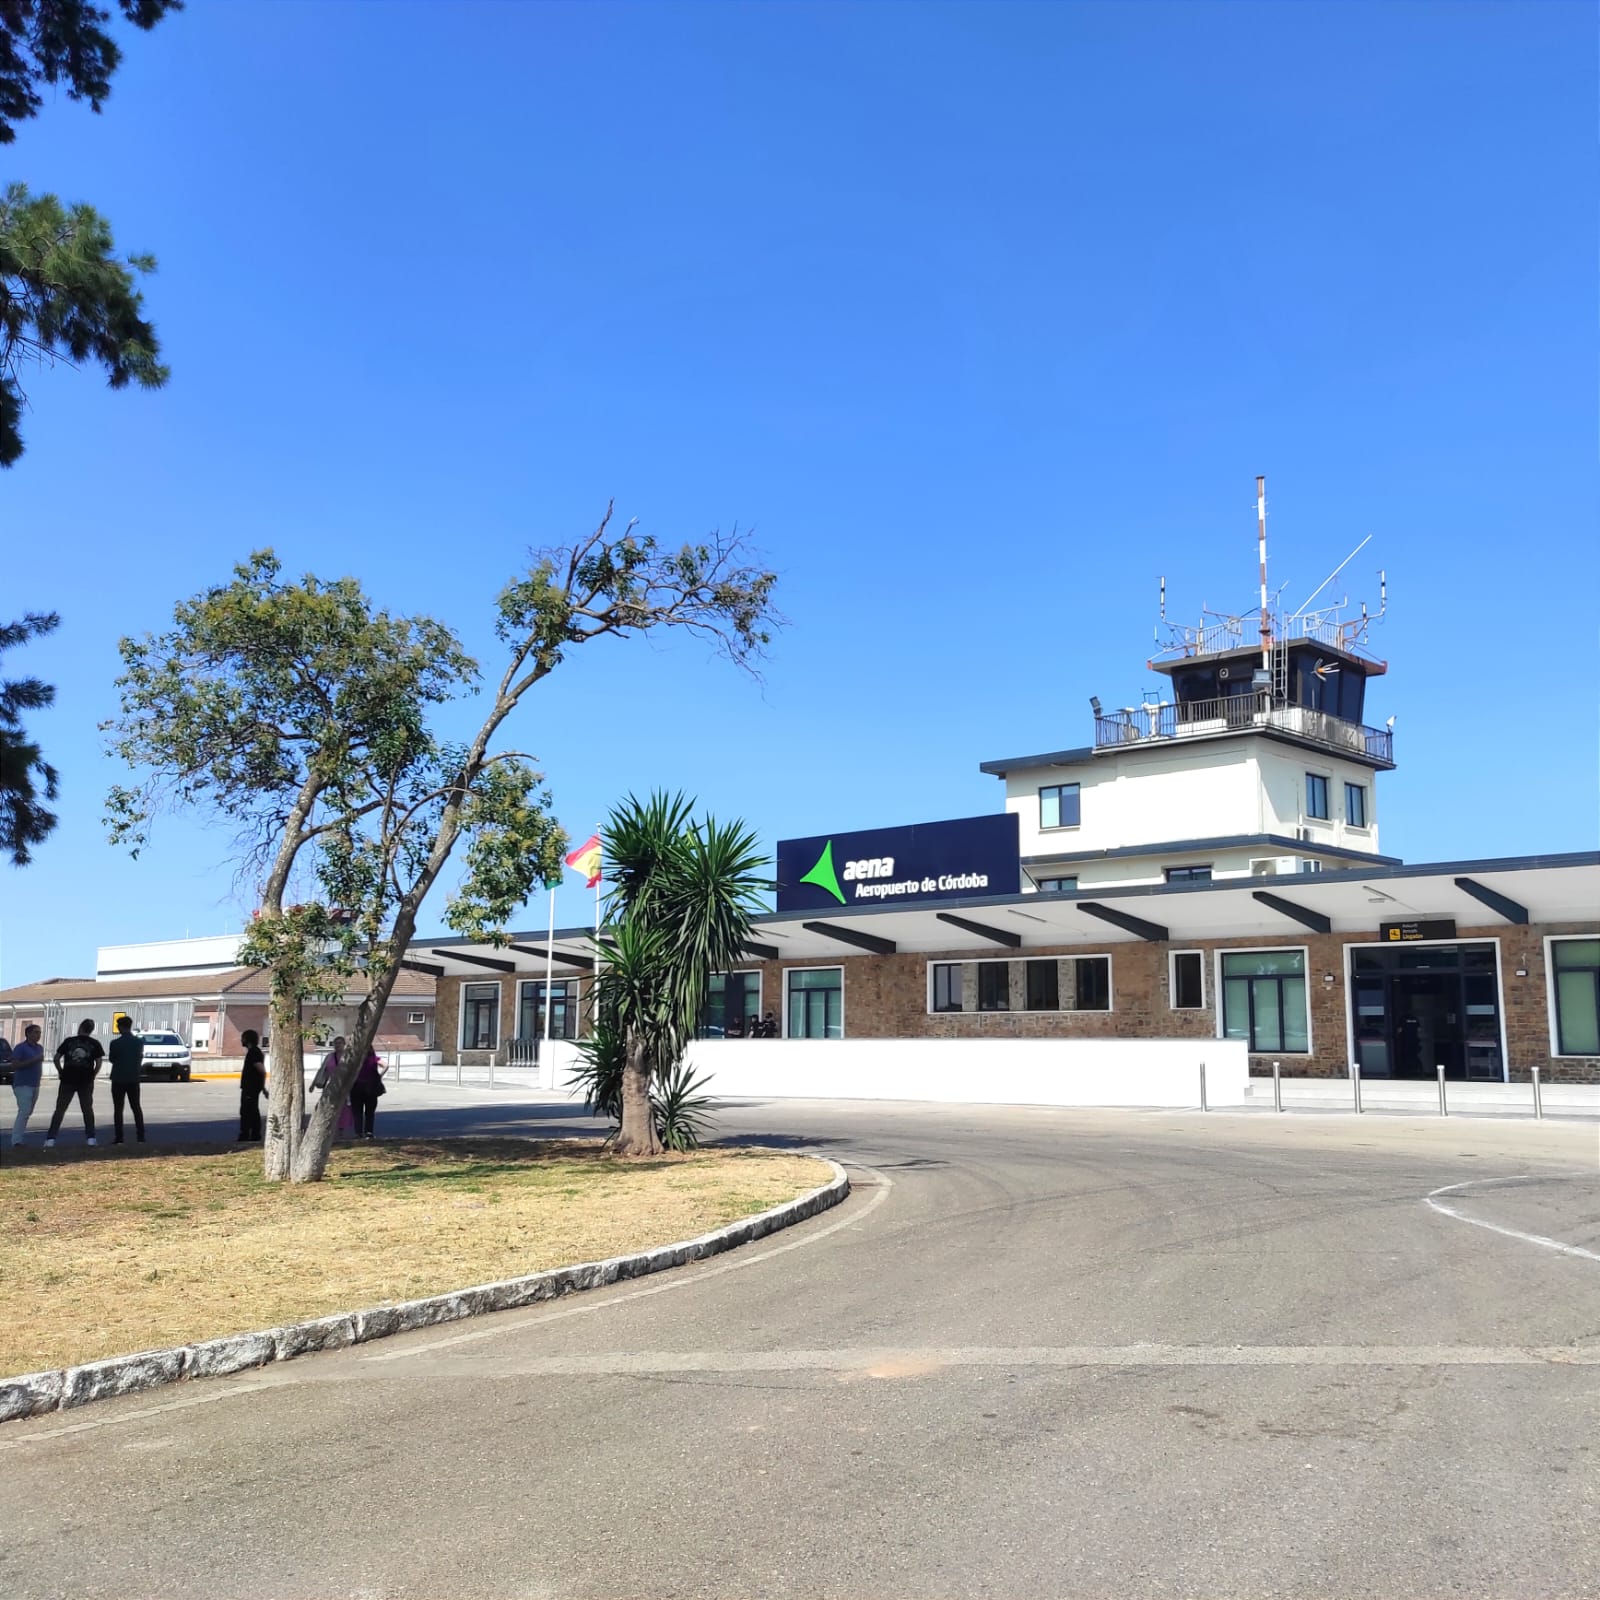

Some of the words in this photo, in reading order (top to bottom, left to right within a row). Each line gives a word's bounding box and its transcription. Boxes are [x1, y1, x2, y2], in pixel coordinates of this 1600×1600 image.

[843, 857, 894, 881] aena
[855, 879, 920, 899] Aeropuerto
[921, 877, 936, 892] de
[938, 873, 988, 891] Córdoba
